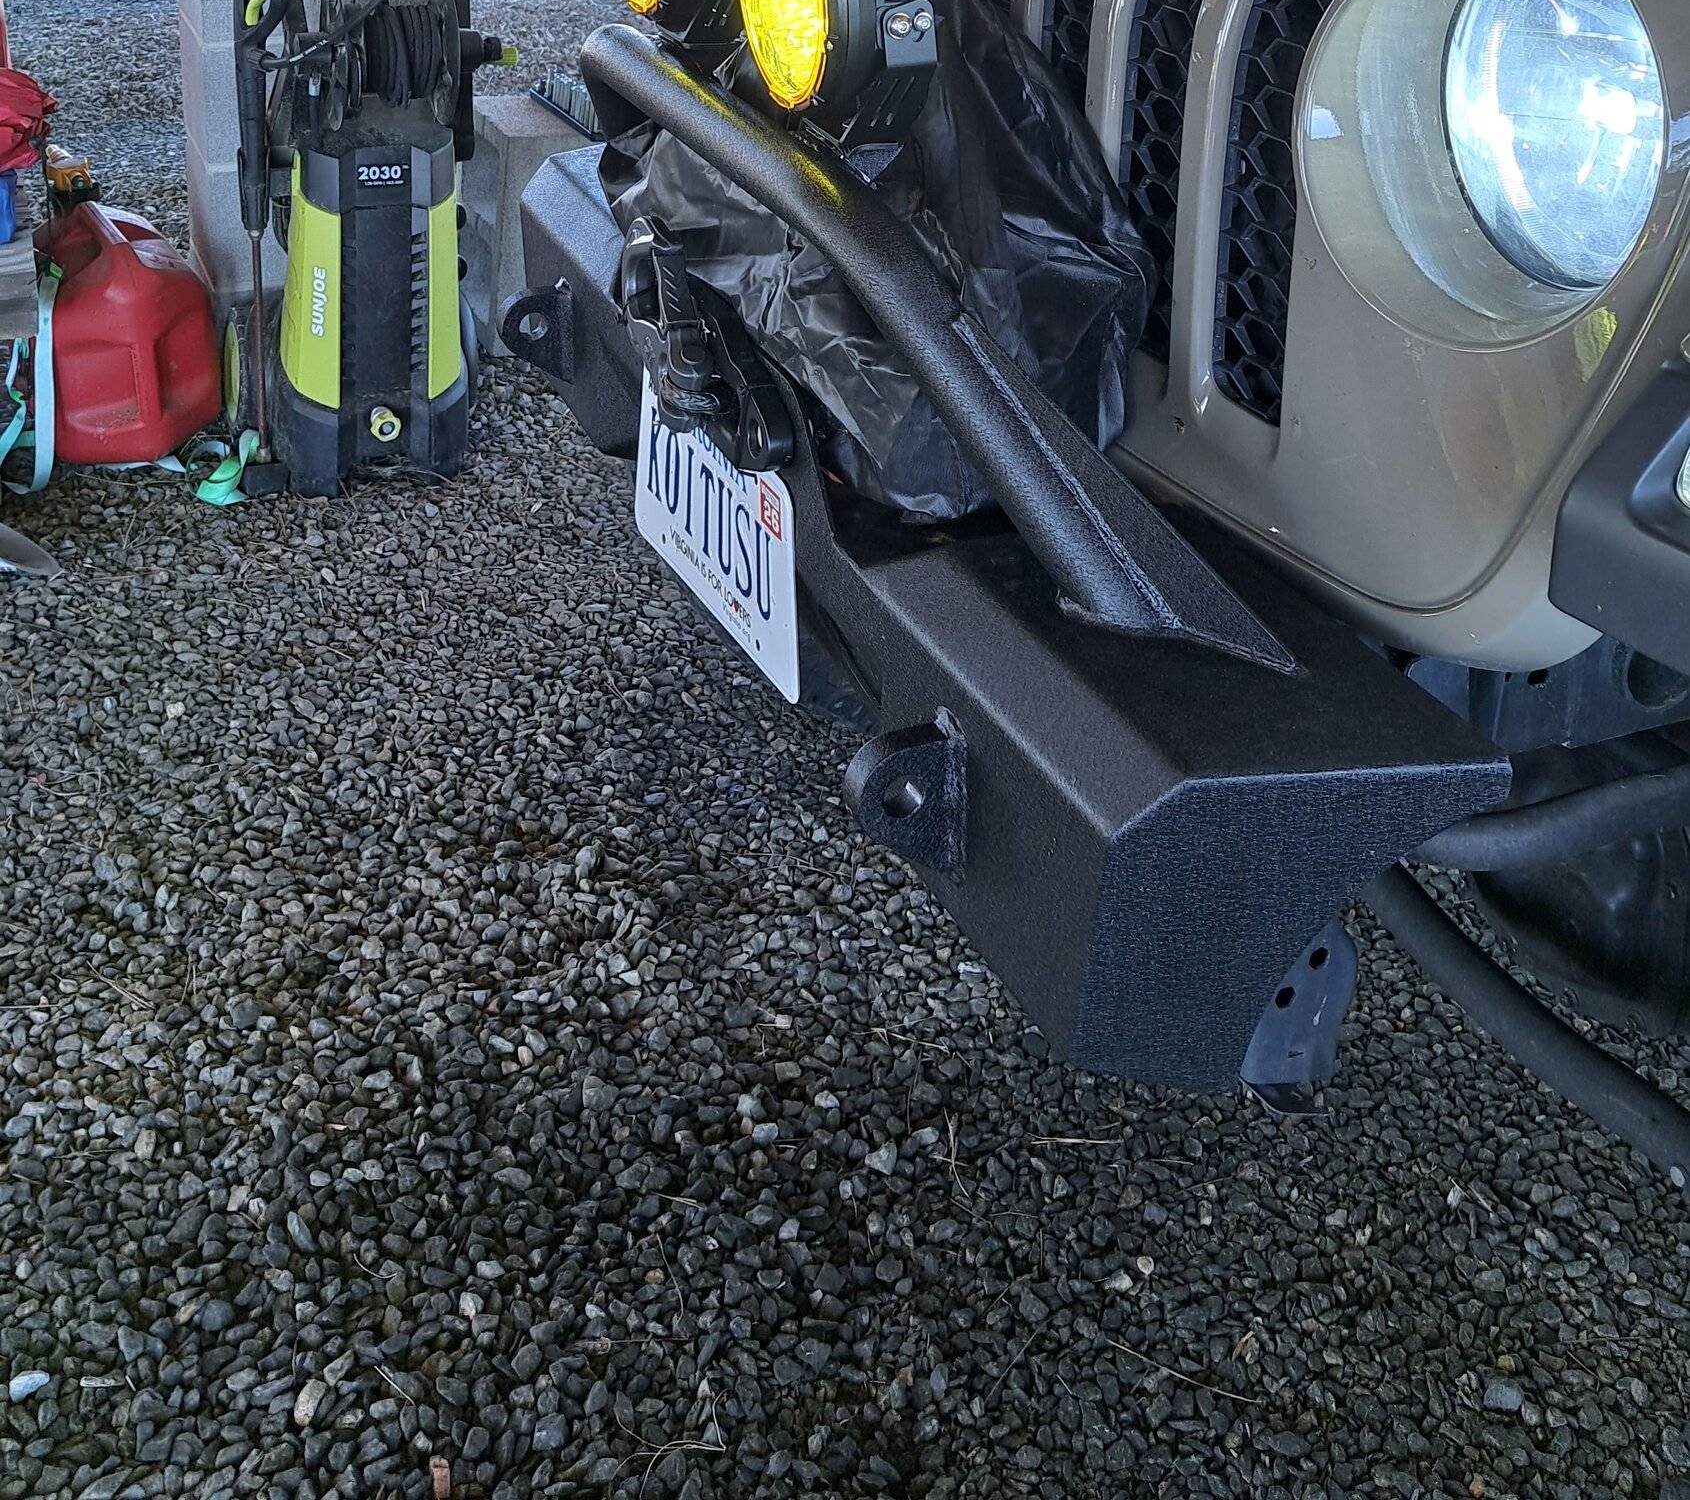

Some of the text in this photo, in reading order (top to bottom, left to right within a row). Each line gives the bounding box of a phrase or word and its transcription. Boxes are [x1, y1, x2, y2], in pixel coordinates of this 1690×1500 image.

[358, 165, 401, 180] 2030
[311, 266, 327, 336] SUNJOE
[763, 500, 779, 534] 26
[670, 525, 700, 572] VIRGINIA
[708, 568, 723, 597] FOR
